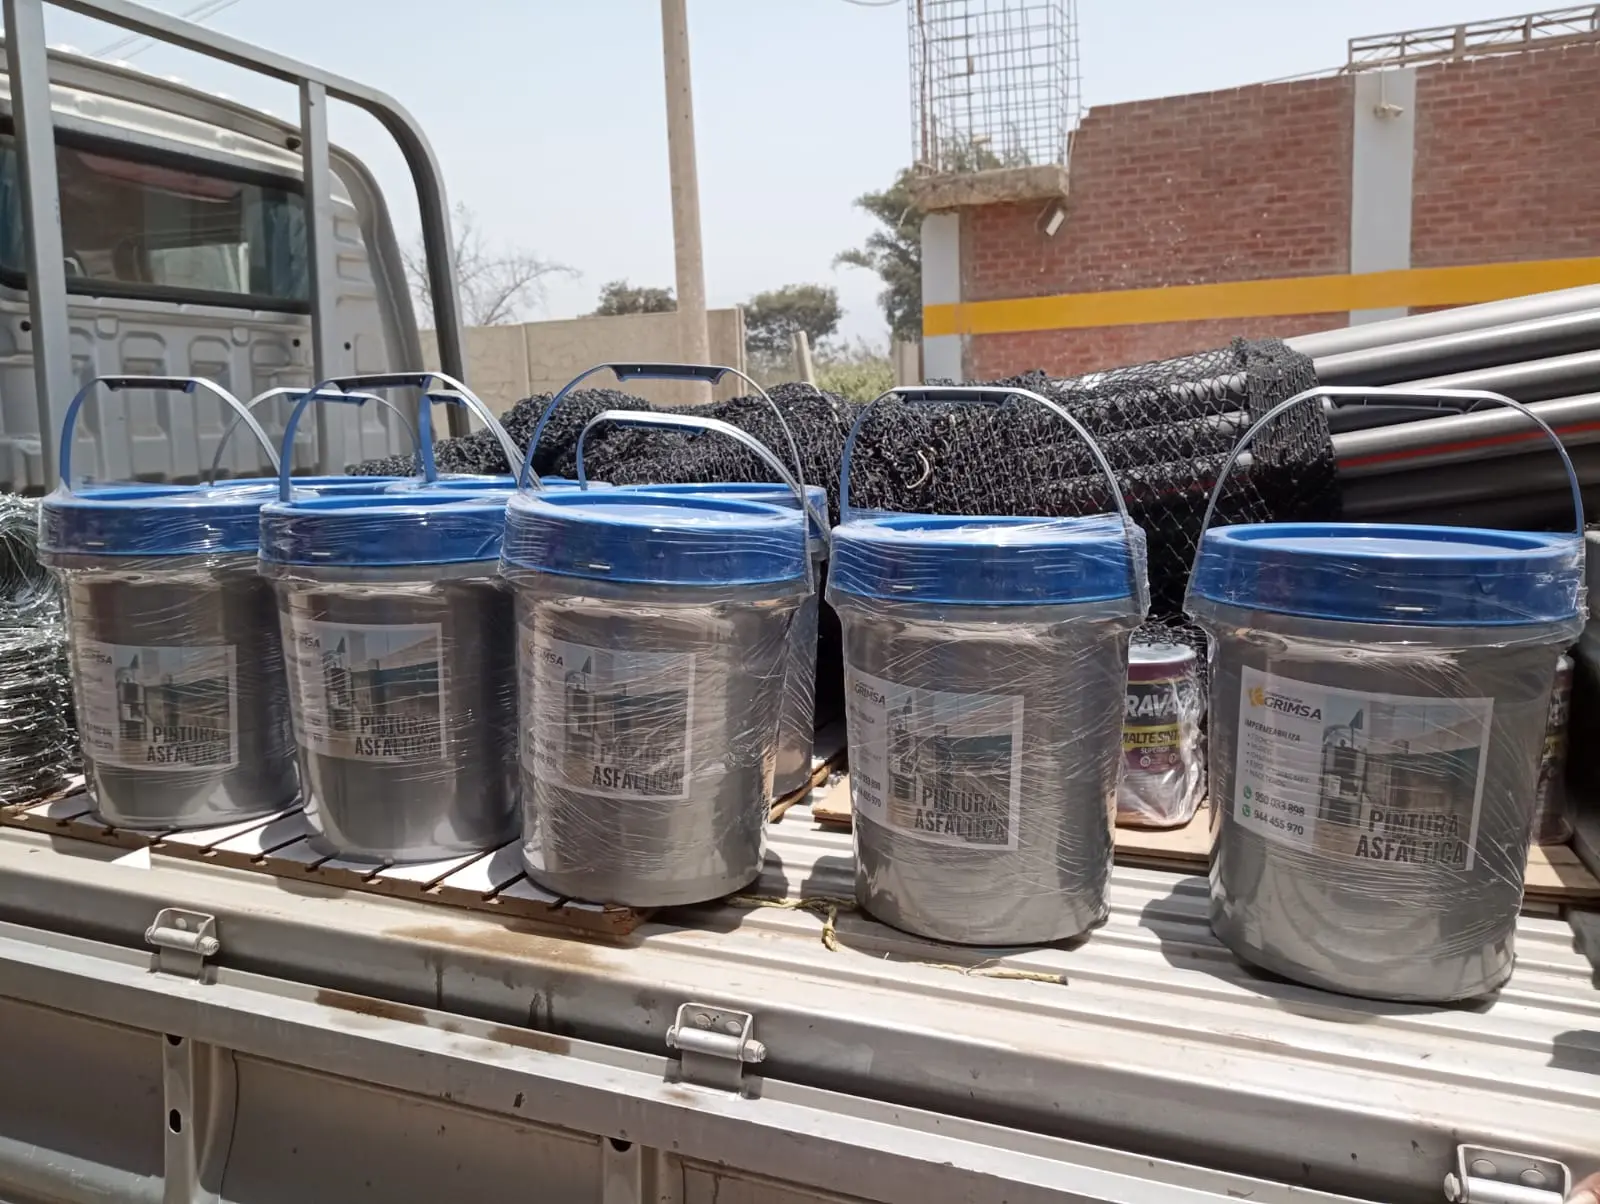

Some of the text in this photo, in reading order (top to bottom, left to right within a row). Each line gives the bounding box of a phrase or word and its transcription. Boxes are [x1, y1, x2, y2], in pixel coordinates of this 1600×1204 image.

[854, 683, 886, 705] GRIMSA
[1264, 696, 1322, 721] GRIMSA
[922, 786, 998, 813] PINTURA
[1286, 821, 1304, 836] 970
[1368, 808, 1459, 838] PINTURA
